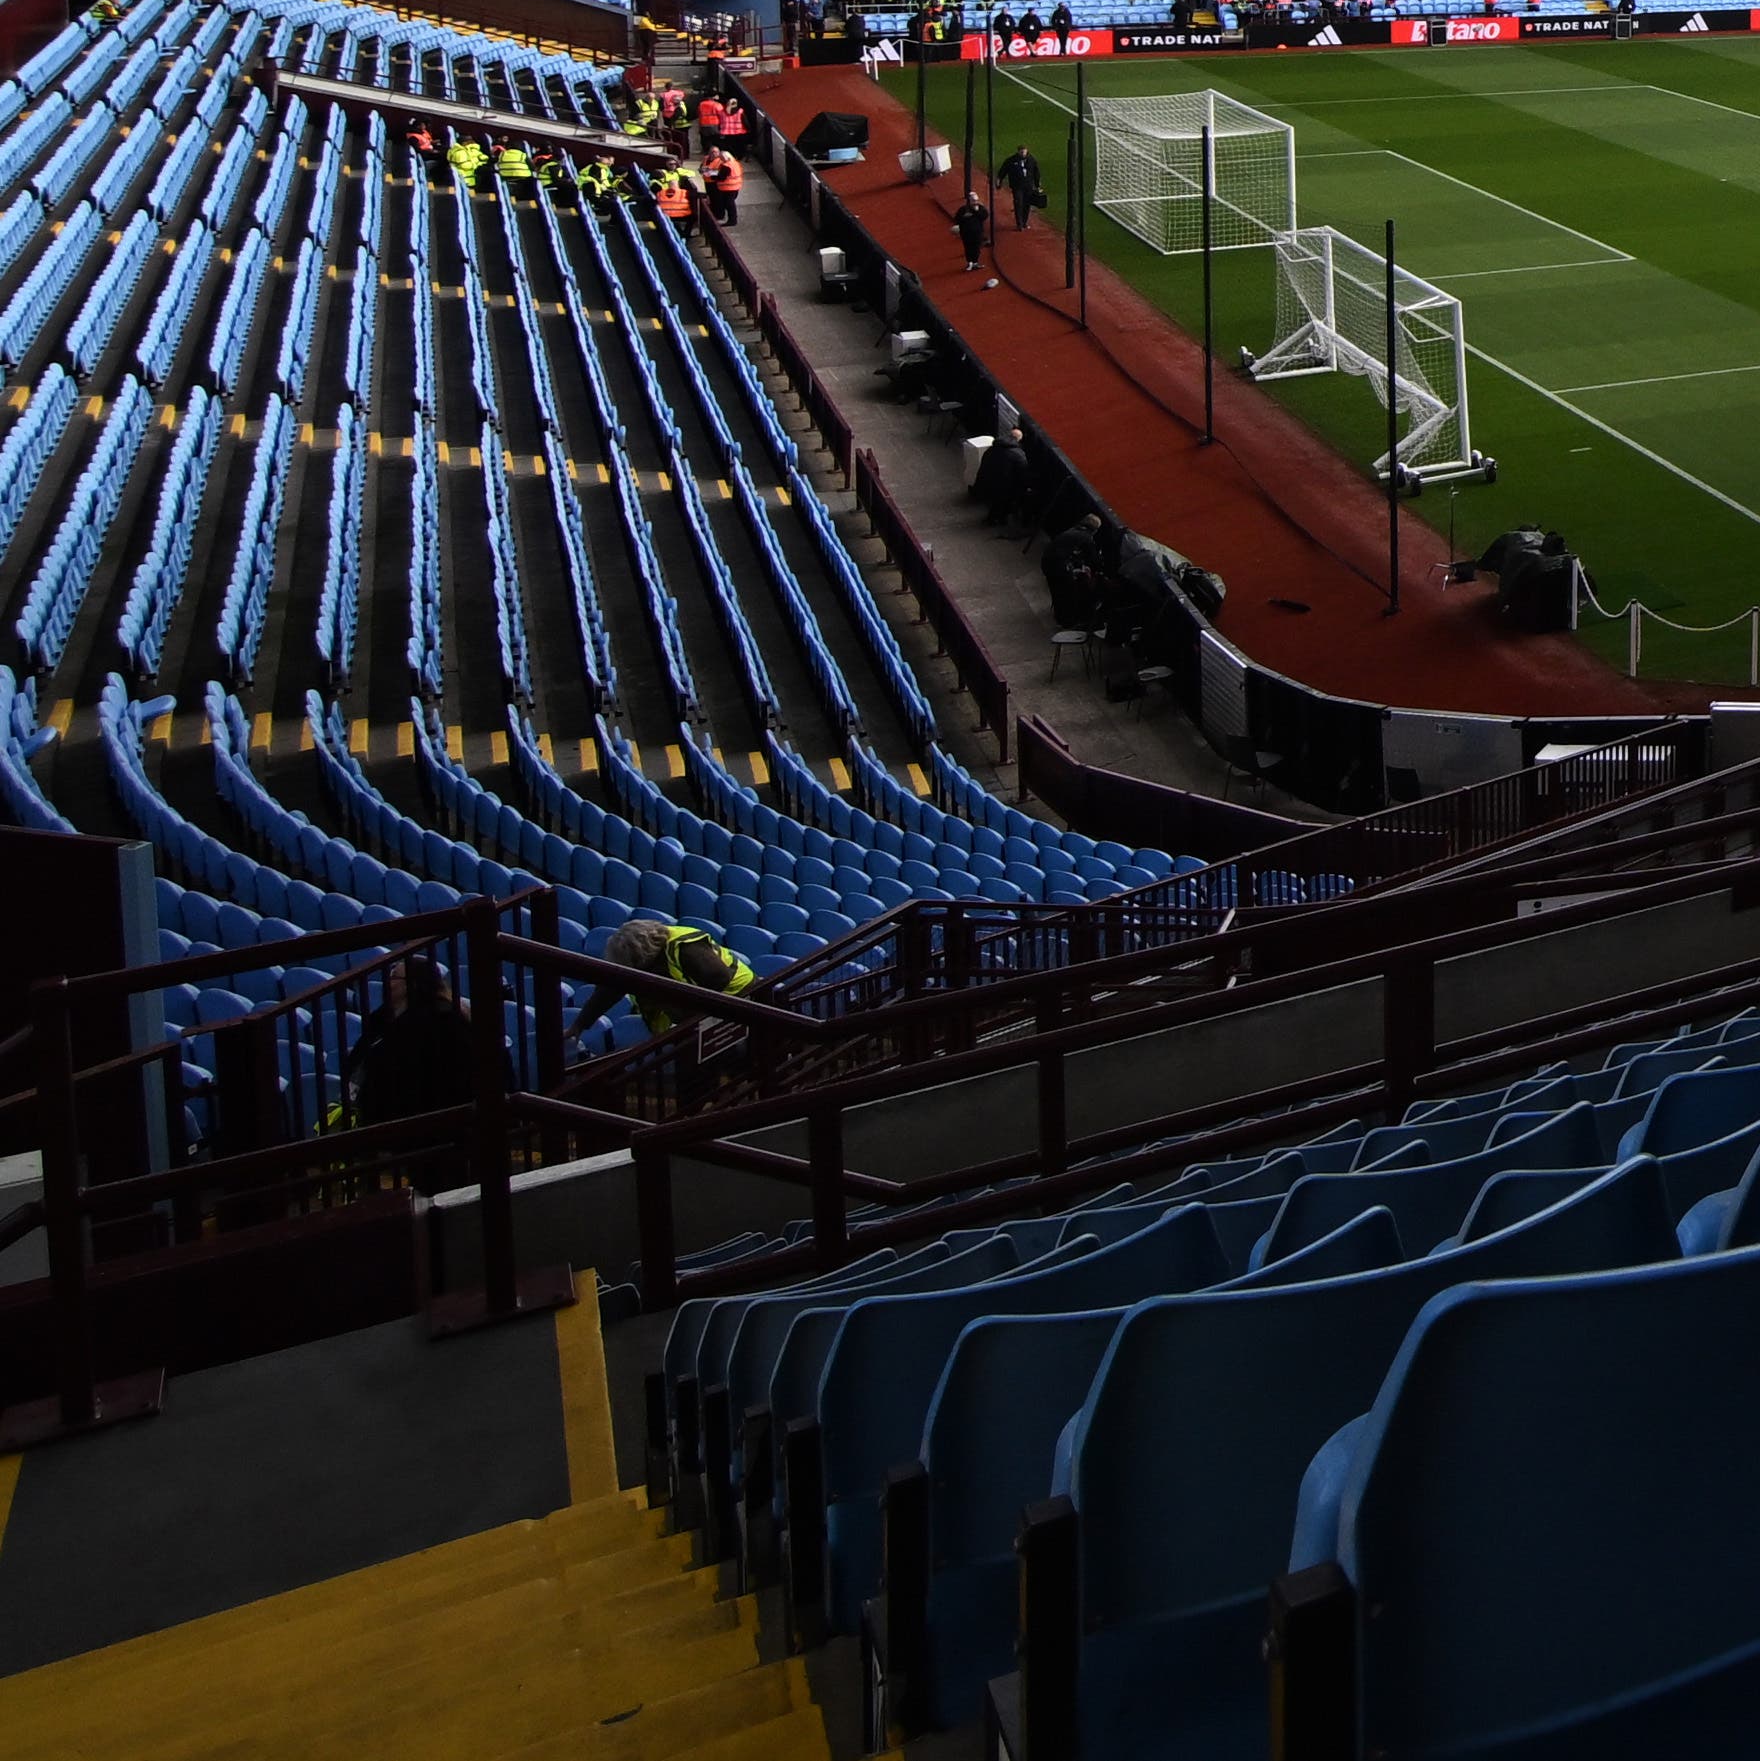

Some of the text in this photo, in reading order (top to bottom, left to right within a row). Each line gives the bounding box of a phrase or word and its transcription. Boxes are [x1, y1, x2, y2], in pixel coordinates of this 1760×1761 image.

[1411, 19, 1500, 42] Btano
[1534, 20, 1639, 32] TRADE NATN
[1133, 36, 1186, 46] TRADE
